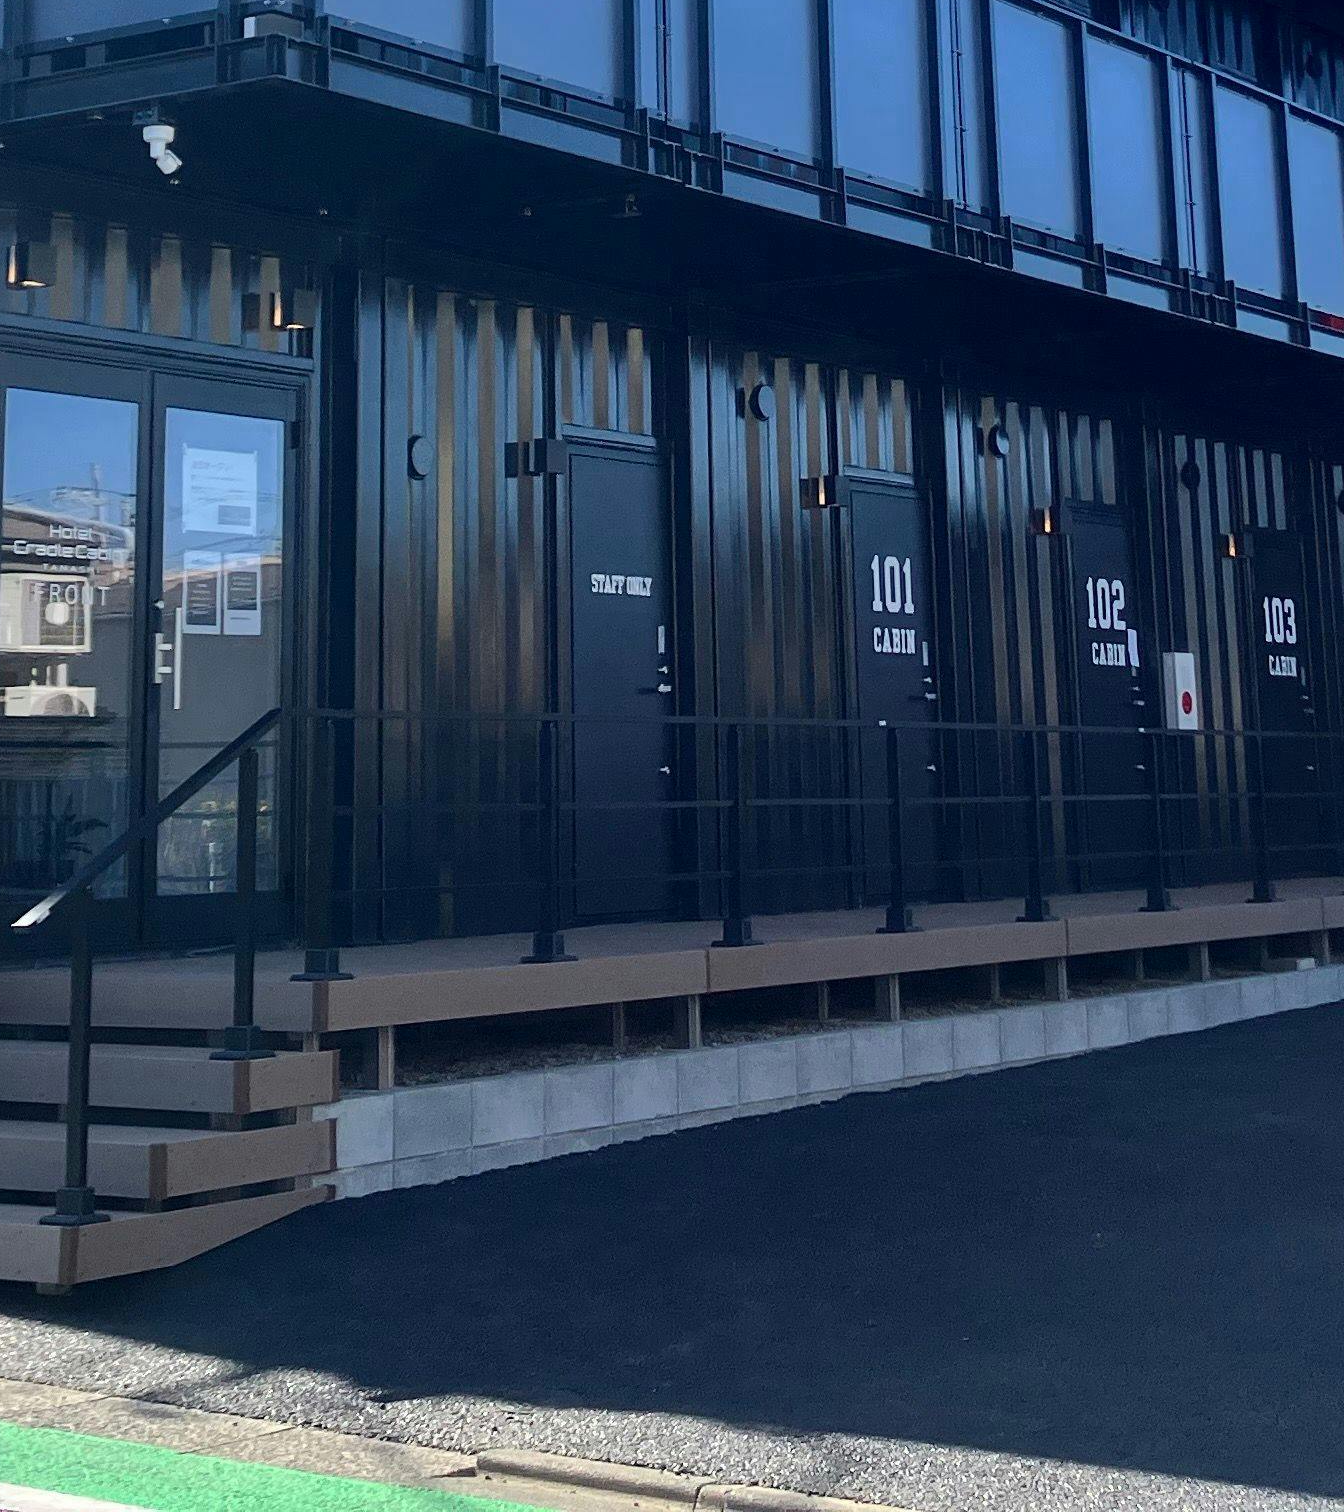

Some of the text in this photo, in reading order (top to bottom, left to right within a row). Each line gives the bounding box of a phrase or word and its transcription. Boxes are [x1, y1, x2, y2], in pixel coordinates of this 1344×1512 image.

[31, 582, 111, 606] FRONT
[591, 573, 625, 595] STAFF
[871, 554, 915, 614] 101
[1086, 576, 1127, 631] 102
[1263, 596, 1297, 644] 103
[873, 627, 916, 654] CABIN
[1091, 641, 1126, 666] CABIN
